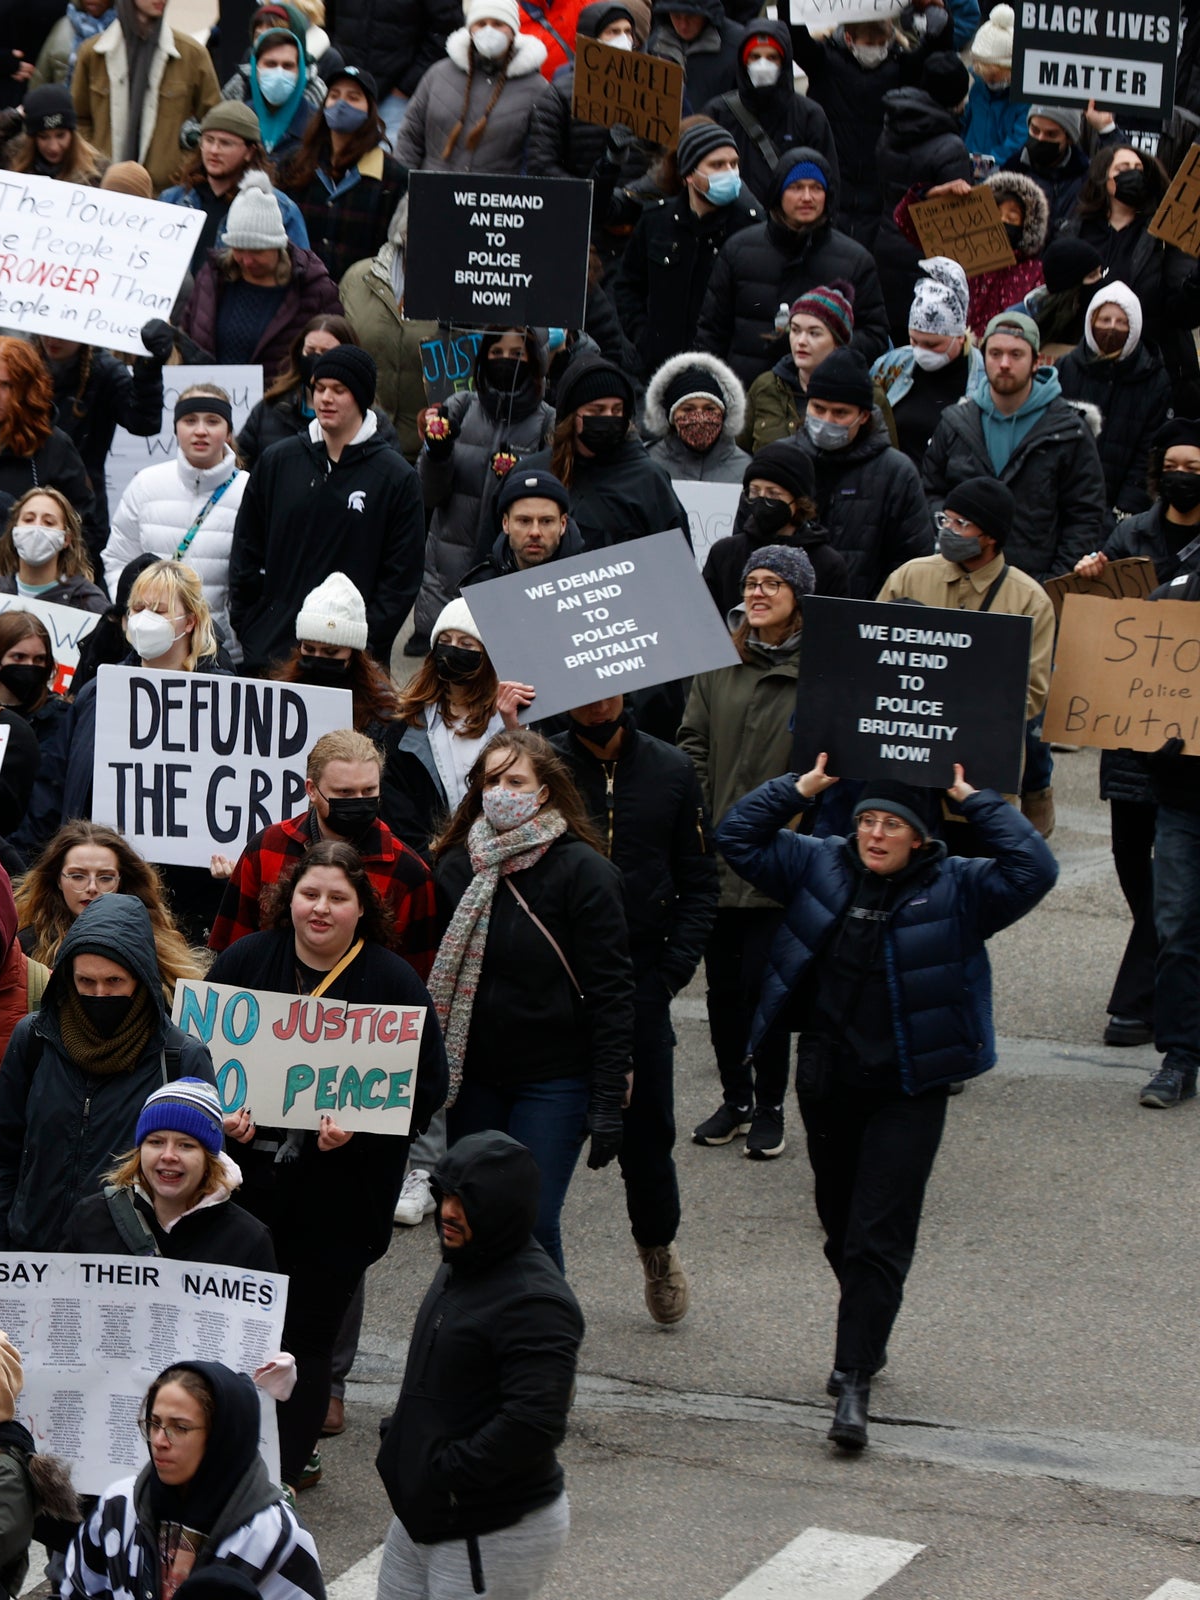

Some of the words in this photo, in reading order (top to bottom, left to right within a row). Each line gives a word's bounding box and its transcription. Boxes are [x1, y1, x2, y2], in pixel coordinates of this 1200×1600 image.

[1022, 2, 1098, 36] BLACK
[1106, 11, 1170, 44] LIVES
[584, 43, 679, 99] CANCEL
[1038, 60, 1147, 96] MATTER
[454, 191, 477, 207] WE
[480, 193, 544, 210] DEMAND
[66, 190, 155, 233] Power
[159, 214, 196, 242] of
[469, 212, 491, 227] AN
[494, 214, 525, 228] END
[32, 226, 113, 267] People
[127, 244, 151, 270] is
[486, 232, 506, 247] TO
[468, 251, 521, 268] POLICE
[112, 272, 173, 311] Than
[454, 270, 533, 288] BRUTALITY
[472, 291, 511, 306] NOW!
[60, 303, 78, 321] in
[84, 307, 141, 339] Powe
[524, 581, 557, 601] WE
[556, 560, 636, 593] DEMAND
[556, 594, 582, 613] AN
[585, 583, 623, 605] END
[582, 607, 610, 624] TO
[571, 618, 638, 647] POLICE
[858, 623, 889, 641] WE
[891, 627, 972, 649] DEMAND
[563, 631, 659, 670] BRUTALITY
[878, 650, 905, 666] AN
[908, 652, 948, 670] END
[595, 656, 646, 680] NOW!
[898, 674, 925, 691] TO
[1128, 677, 1193, 699] Police
[129, 676, 308, 759] DEFUND
[875, 696, 944, 716] POLICE
[858, 718, 958, 742] BRUTALITY
[880, 743, 931, 763] NOW!
[108, 761, 192, 838] THE
[178, 984, 260, 1046] NO
[272, 999, 421, 1046] JUSTICE
[283, 1063, 413, 1118] PEACE
[80, 1263, 161, 1288] THEIR
[184, 1273, 273, 1306] NAMES
